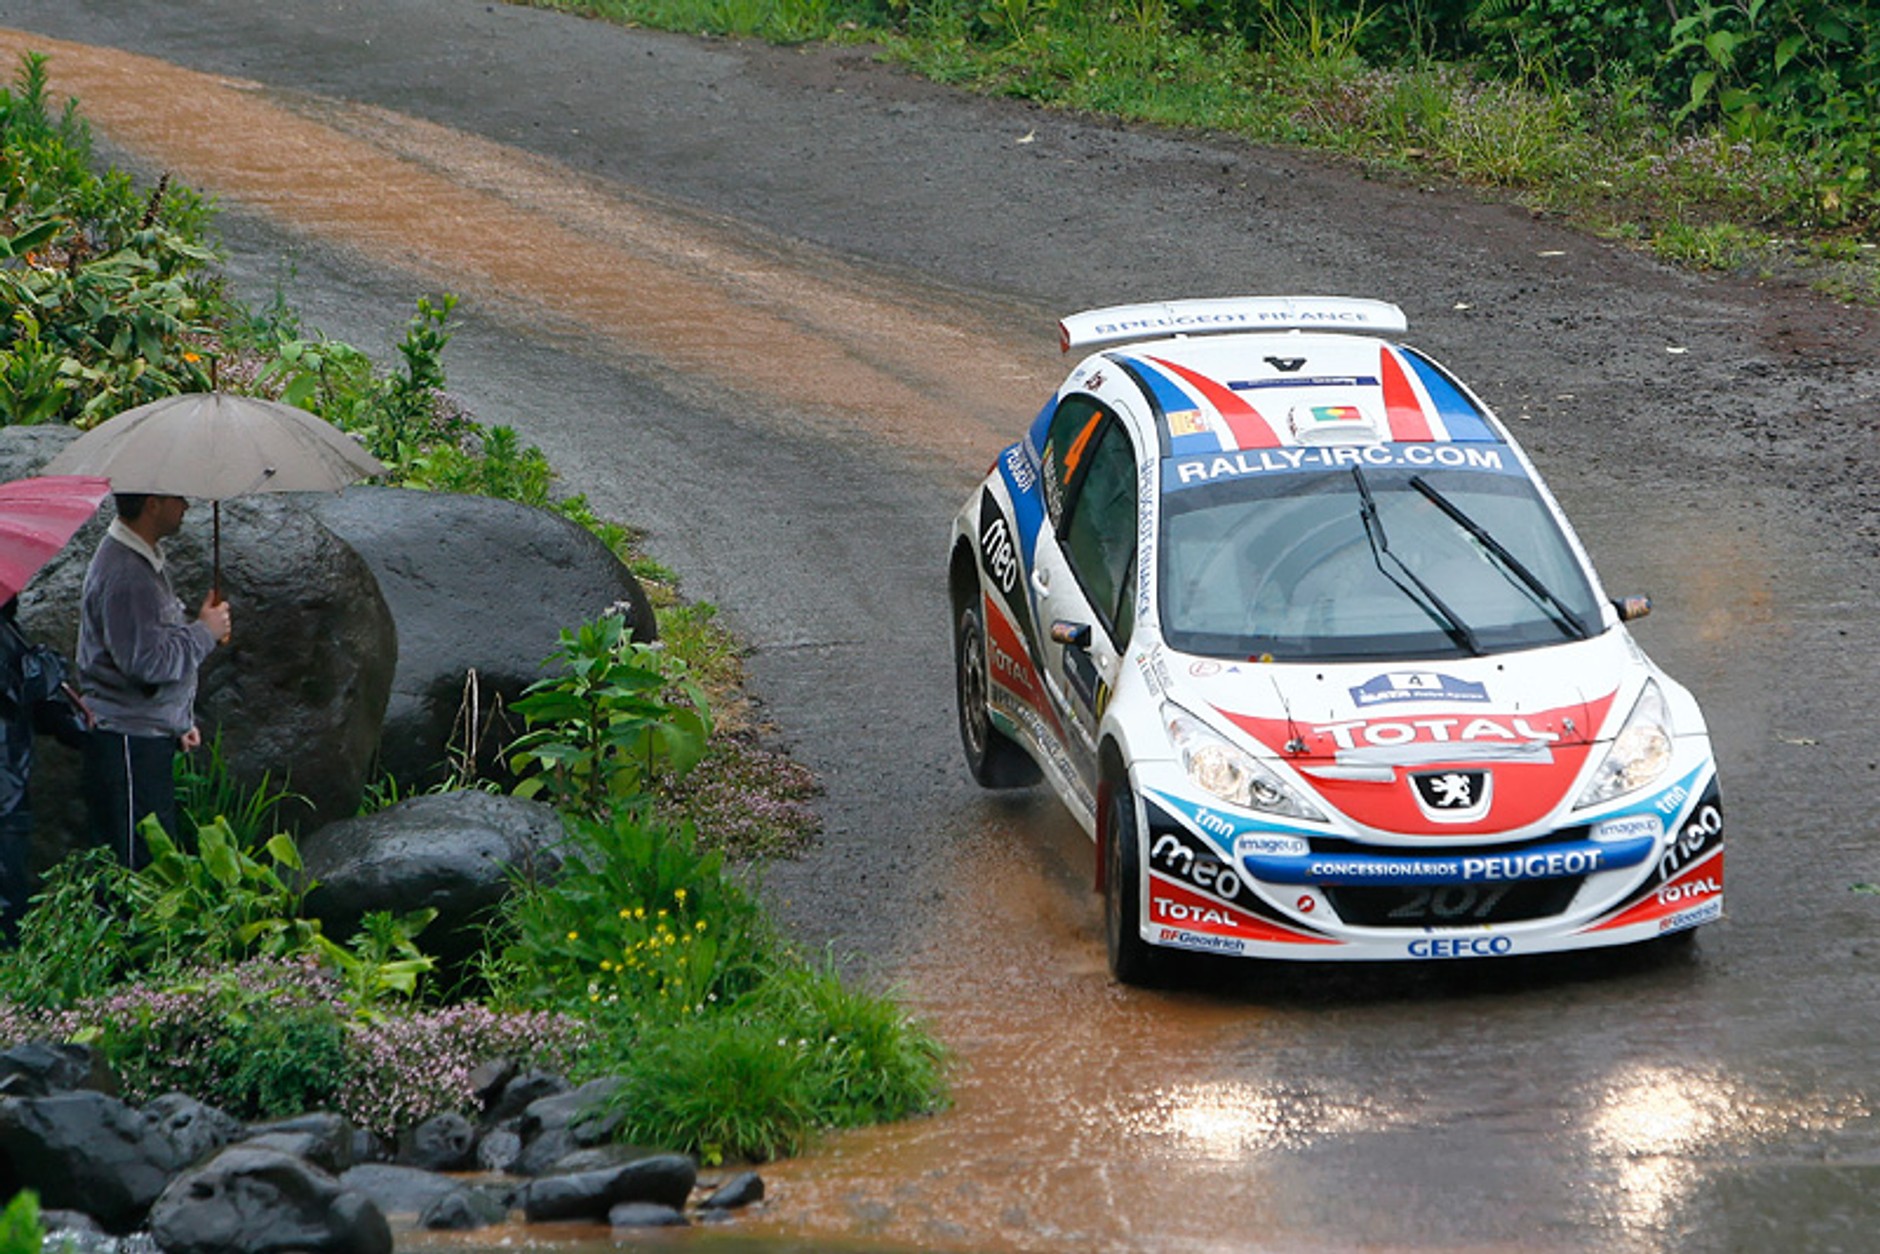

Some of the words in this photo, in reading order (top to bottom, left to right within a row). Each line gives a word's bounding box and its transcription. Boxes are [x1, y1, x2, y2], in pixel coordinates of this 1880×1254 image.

[1119, 311, 1248, 330] PEUGEOT
[1257, 311, 1370, 323] FINANCE
[1176, 445, 1503, 483] RALLY-IRC.COM
[981, 518, 1017, 594] meo
[989, 635, 1034, 690] TOTAL
[1311, 717, 1561, 750] TOTAL
[1655, 784, 1688, 814] tmn
[1194, 807, 1235, 839] tmn
[1238, 838, 1304, 853] imageup
[1658, 804, 1723, 882] meo
[1151, 833, 1241, 900] meo
[1310, 861, 1458, 877] CONCESSIONÁRIOS
[1462, 849, 1603, 880] PEUGEOT
[1656, 877, 1723, 906] TOTAL
[1153, 897, 1239, 927] TOTAL
[1158, 928, 1246, 951] BFGoodrich
[1406, 935, 1513, 958] GEFCO
